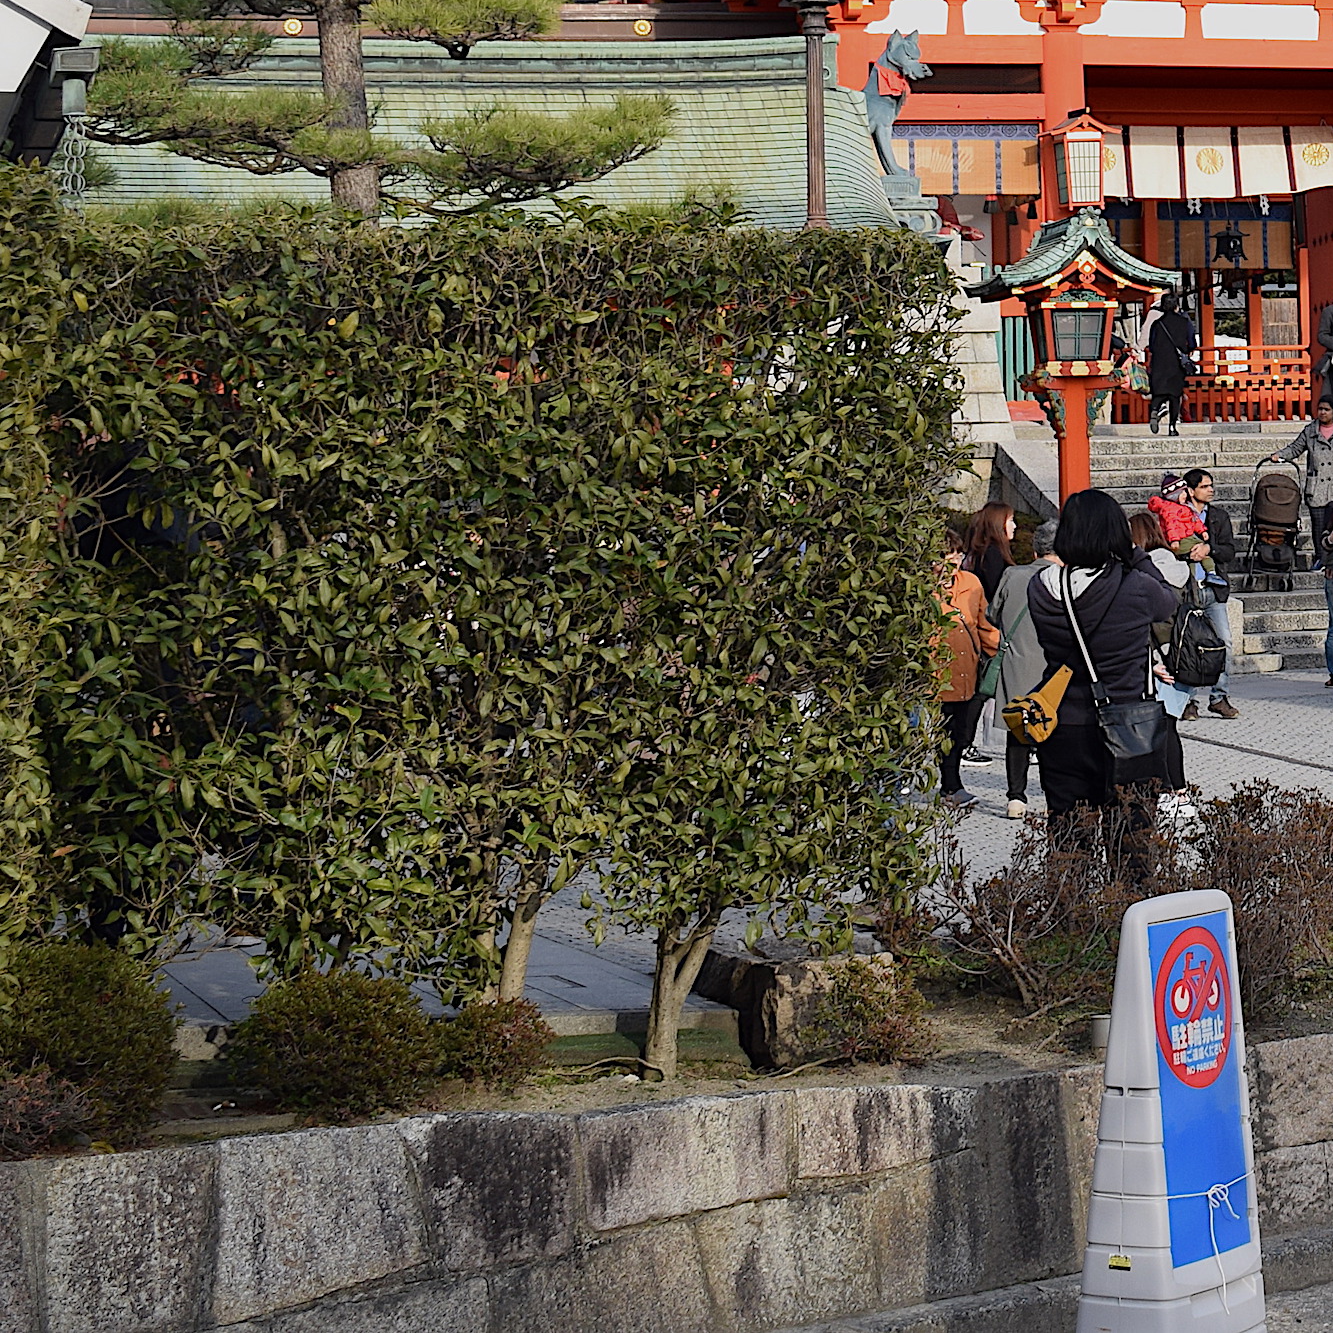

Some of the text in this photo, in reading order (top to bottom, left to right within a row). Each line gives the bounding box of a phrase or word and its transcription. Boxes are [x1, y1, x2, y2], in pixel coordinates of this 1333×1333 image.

[1171, 1014, 1225, 1051] 駐輪禁止
[1186, 1059, 1218, 1076] NO PARKING
